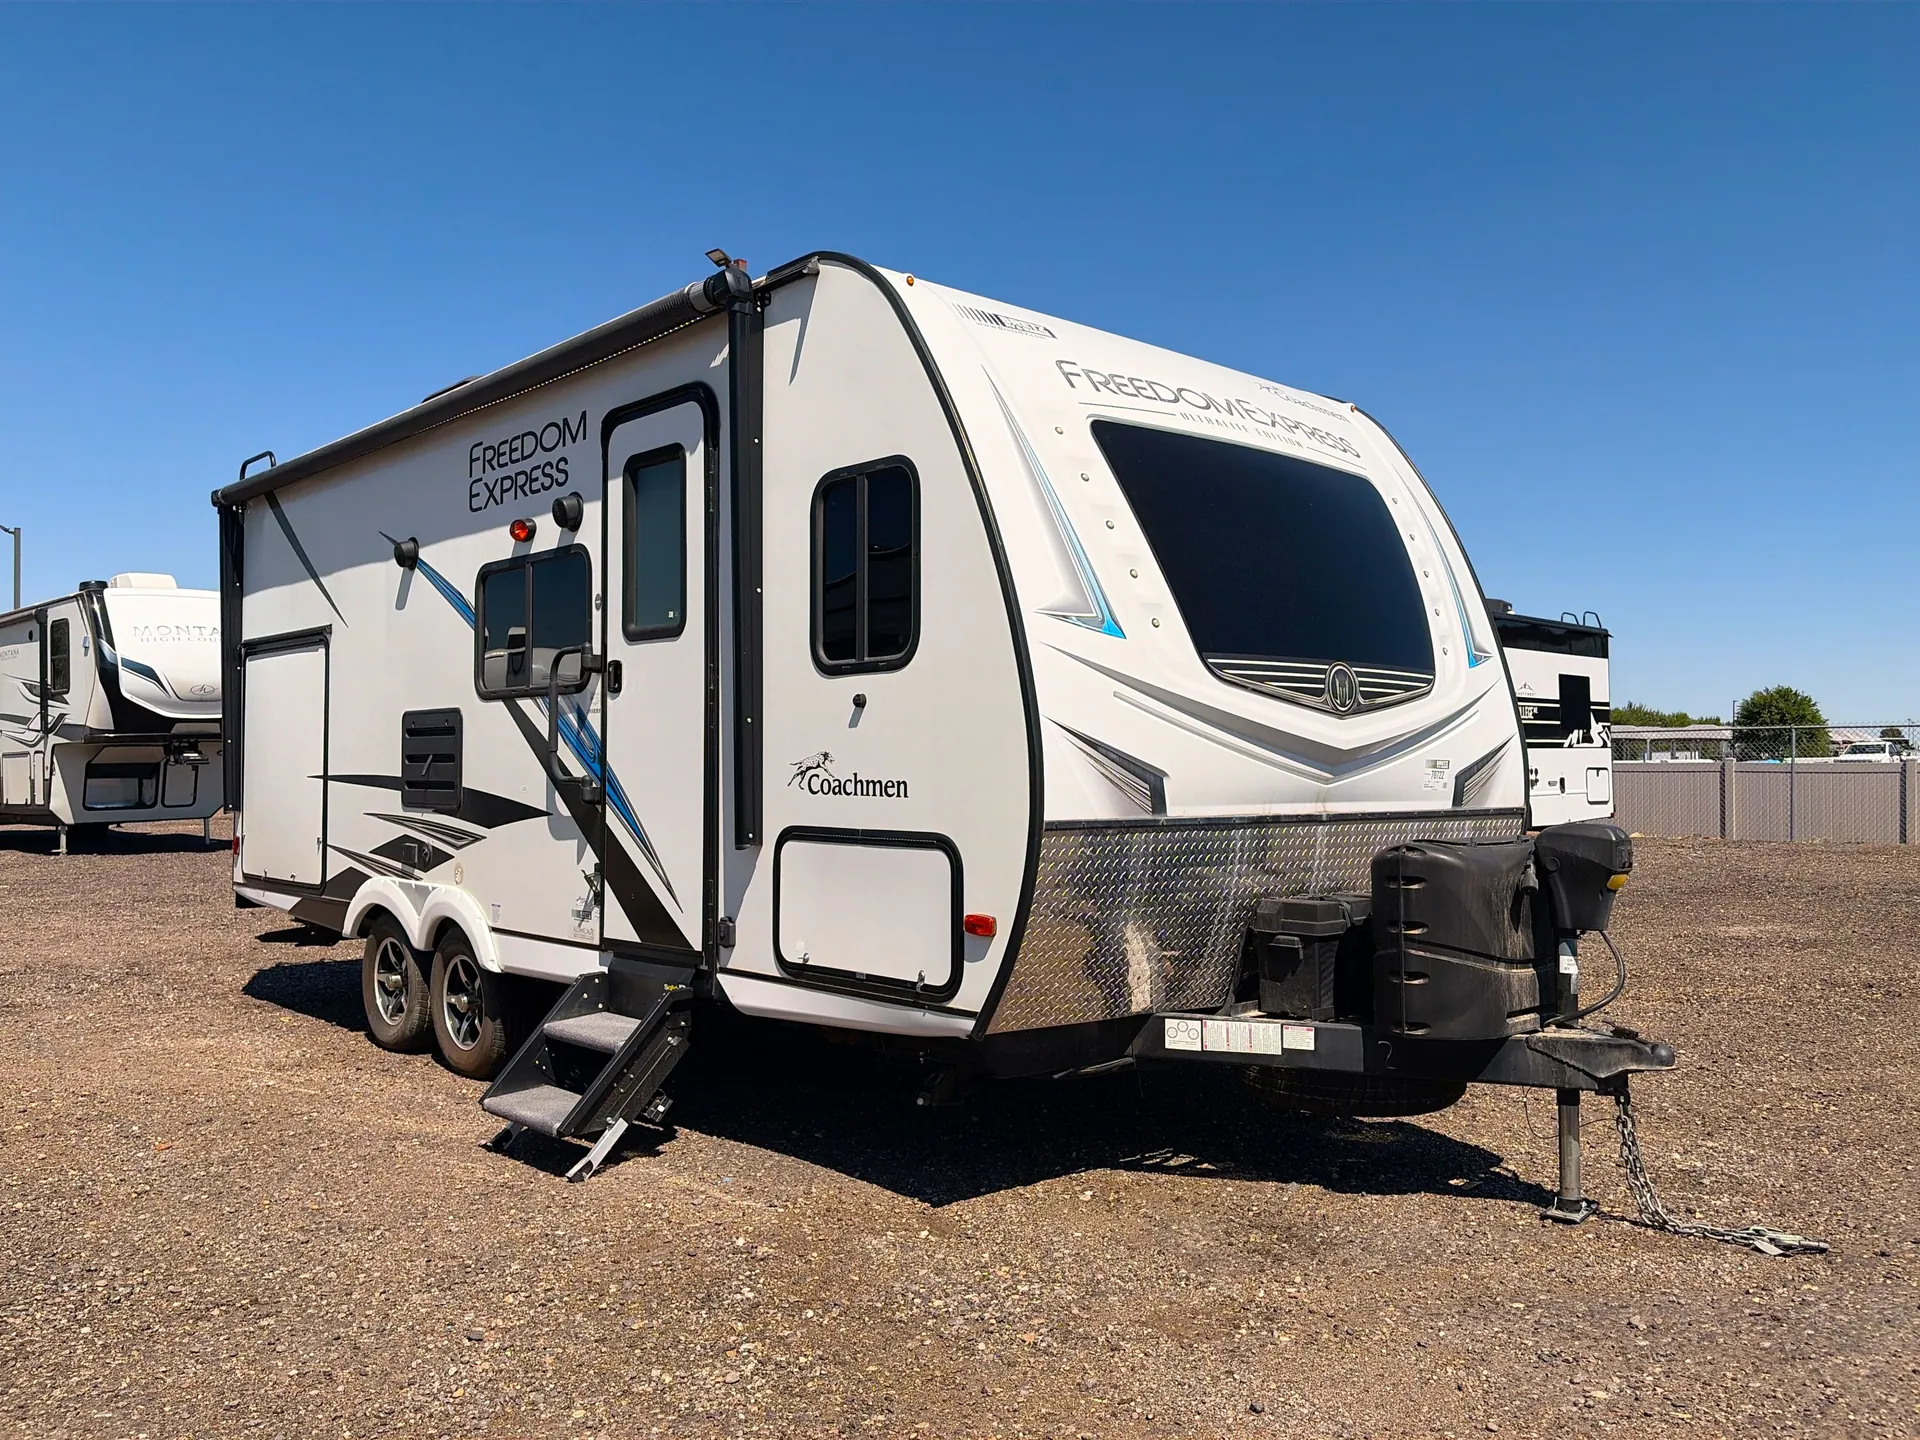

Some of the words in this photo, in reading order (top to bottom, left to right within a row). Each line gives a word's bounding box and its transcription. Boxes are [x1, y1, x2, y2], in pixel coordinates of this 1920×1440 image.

[1055, 359, 1246, 420] FREEDOM
[1235, 398, 1362, 459] EXPRESS
[1179, 411, 1249, 433] ULTRALITE
[1254, 428, 1304, 449] EDITION
[469, 409, 588, 478] FREEDOM
[469, 456, 569, 513] EXPRESS
[807, 772, 909, 798] Coachmen
